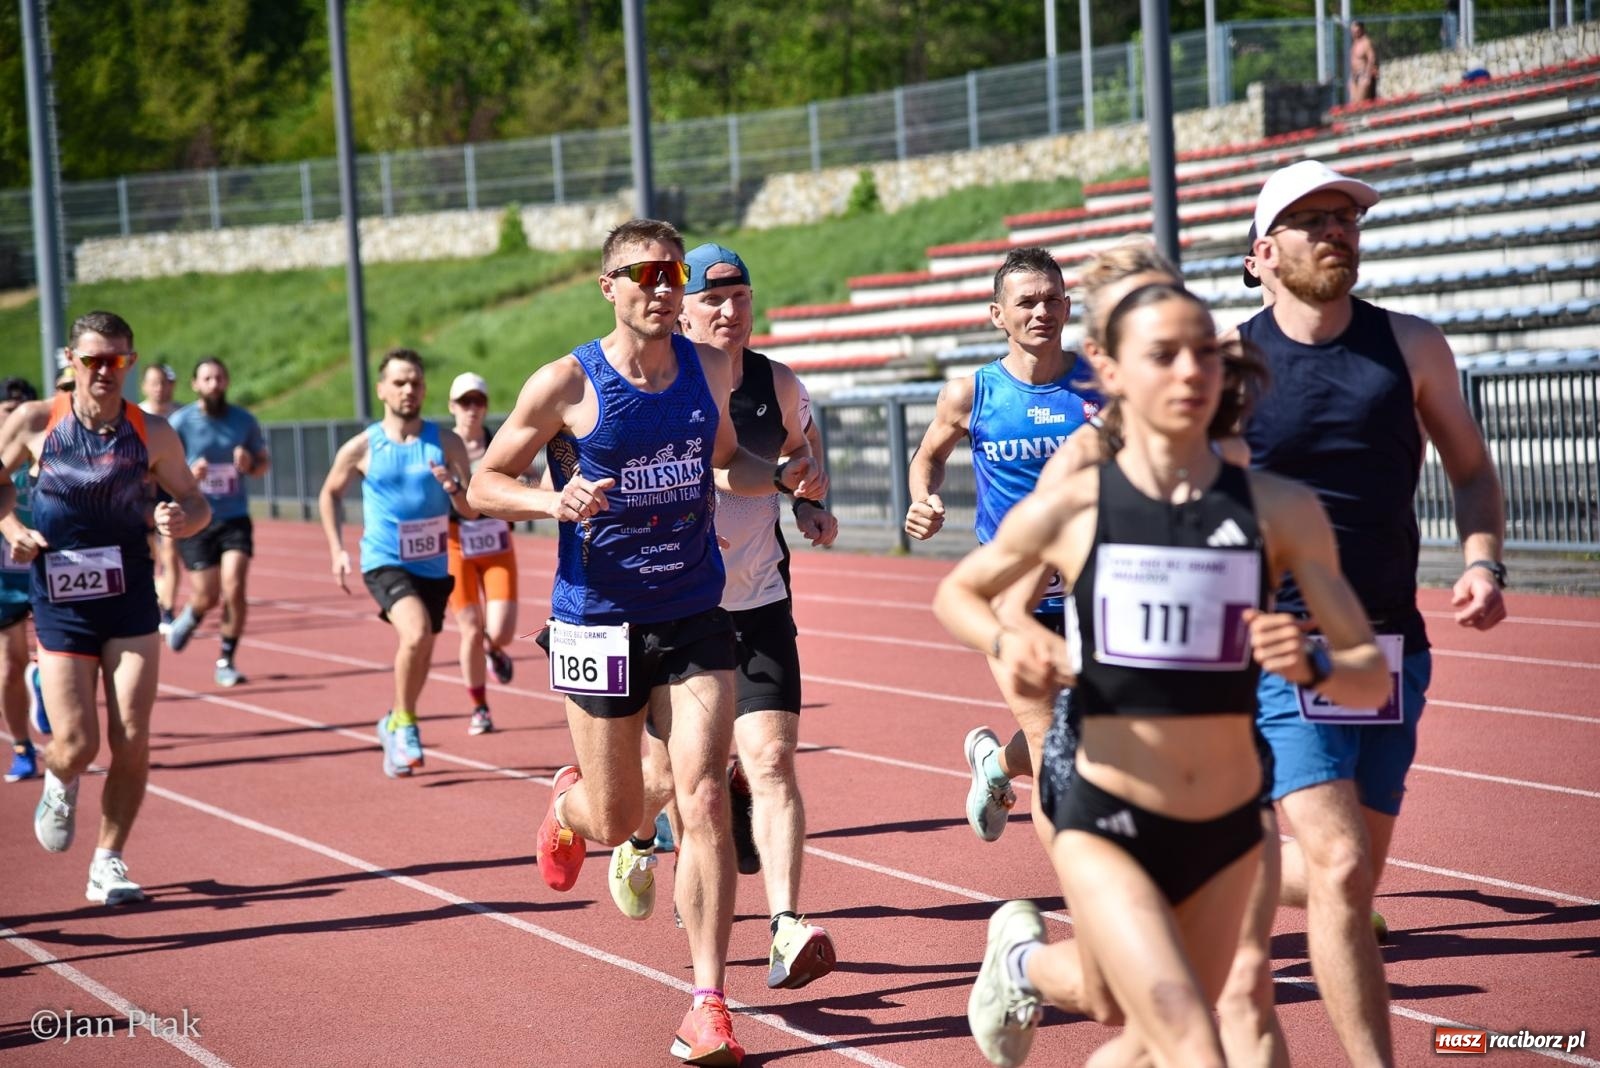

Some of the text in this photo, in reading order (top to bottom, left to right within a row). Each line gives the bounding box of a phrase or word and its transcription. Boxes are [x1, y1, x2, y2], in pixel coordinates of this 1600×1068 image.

[982, 435, 1070, 461] RUNN
[624, 459, 704, 490] SILESIAN
[626, 486, 701, 508] TRIATHLON TEAM
[408, 536, 435, 554] 158
[469, 535, 495, 550] 130
[641, 542, 680, 554] CAPEK
[639, 562, 685, 574] ERIGO
[58, 571, 103, 592] 242
[1140, 603, 1190, 644] 111
[584, 631, 607, 639] GRANIC
[560, 654, 598, 682] 186
